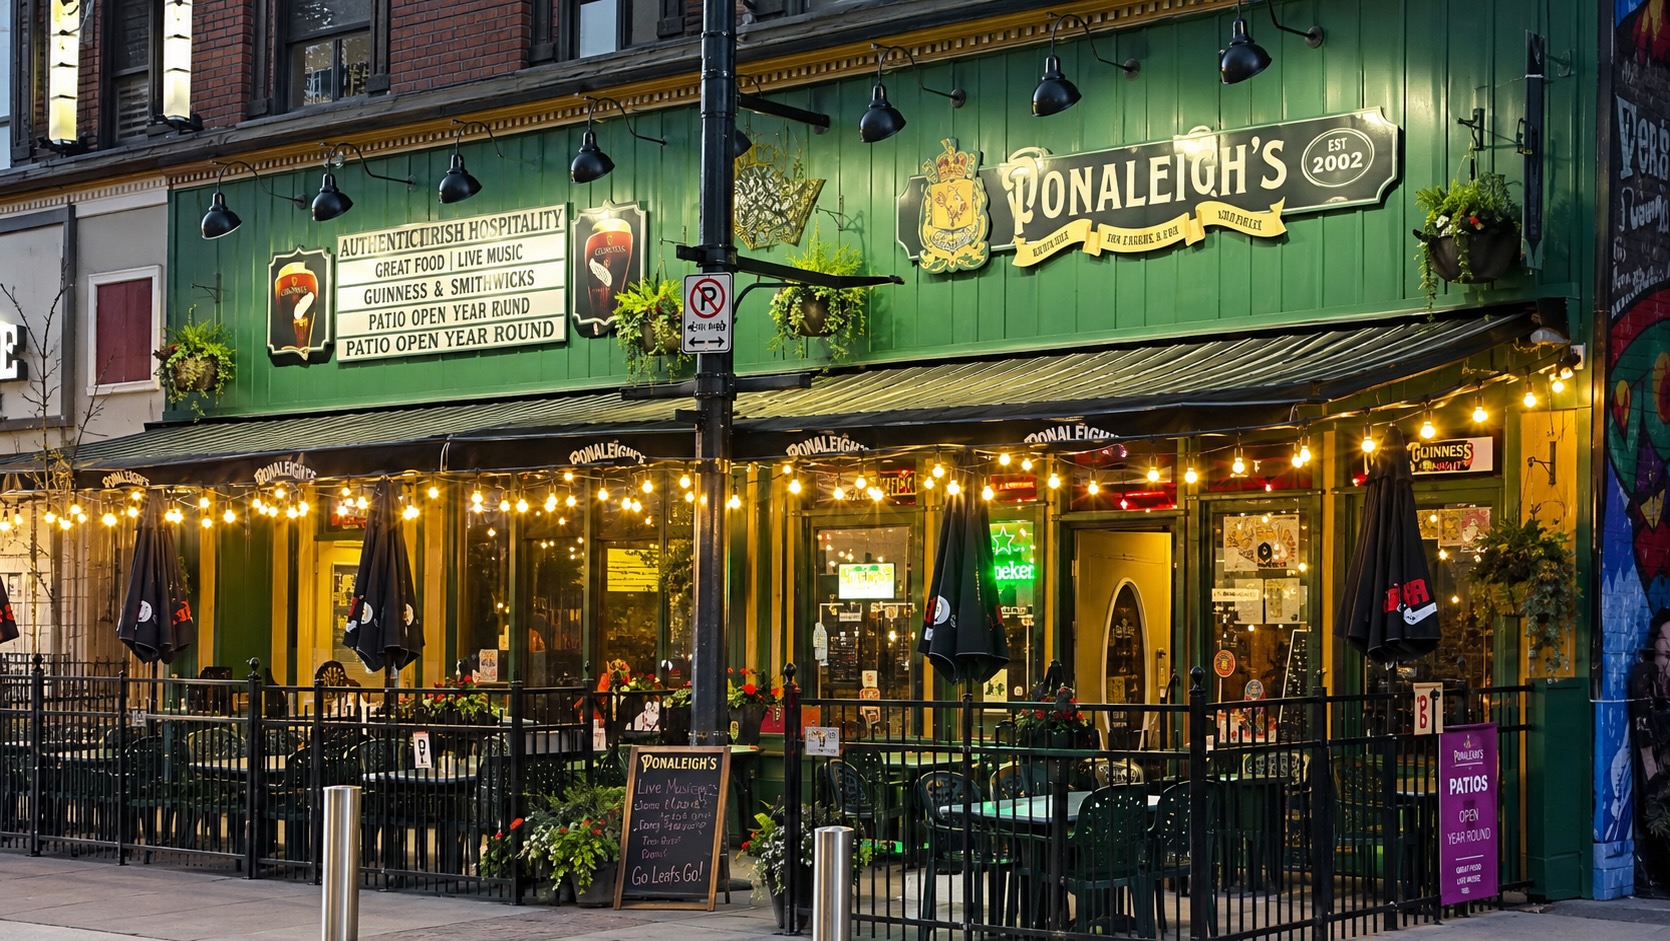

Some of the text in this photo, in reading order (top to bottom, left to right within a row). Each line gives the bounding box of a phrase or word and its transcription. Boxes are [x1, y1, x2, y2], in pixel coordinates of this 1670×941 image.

[1327, 137, 1348, 152] EST
[1312, 151, 1363, 174] 2002
[468, 208, 563, 240] HOSPITALITY
[375, 258, 411, 278] GREAT
[414, 254, 445, 274] FOOD
[458, 249, 483, 268] LIVE
[486, 243, 523, 264] MUSIC
[364, 269, 535, 305] GUINNESS & SMITHWICKS
[369, 311, 406, 331] PATIO
[411, 306, 446, 327] OPEN
[453, 302, 487, 322] YEAR
[346, 320, 555, 357] PATIO OPEN YEAR ROUND
[1449, 774, 1488, 795] PATIOS
[1458, 808, 1479, 823] OPEN
[1447, 827, 1491, 845] YEAR ROUND
[631, 861, 704, 886] Go Leafs Go!
